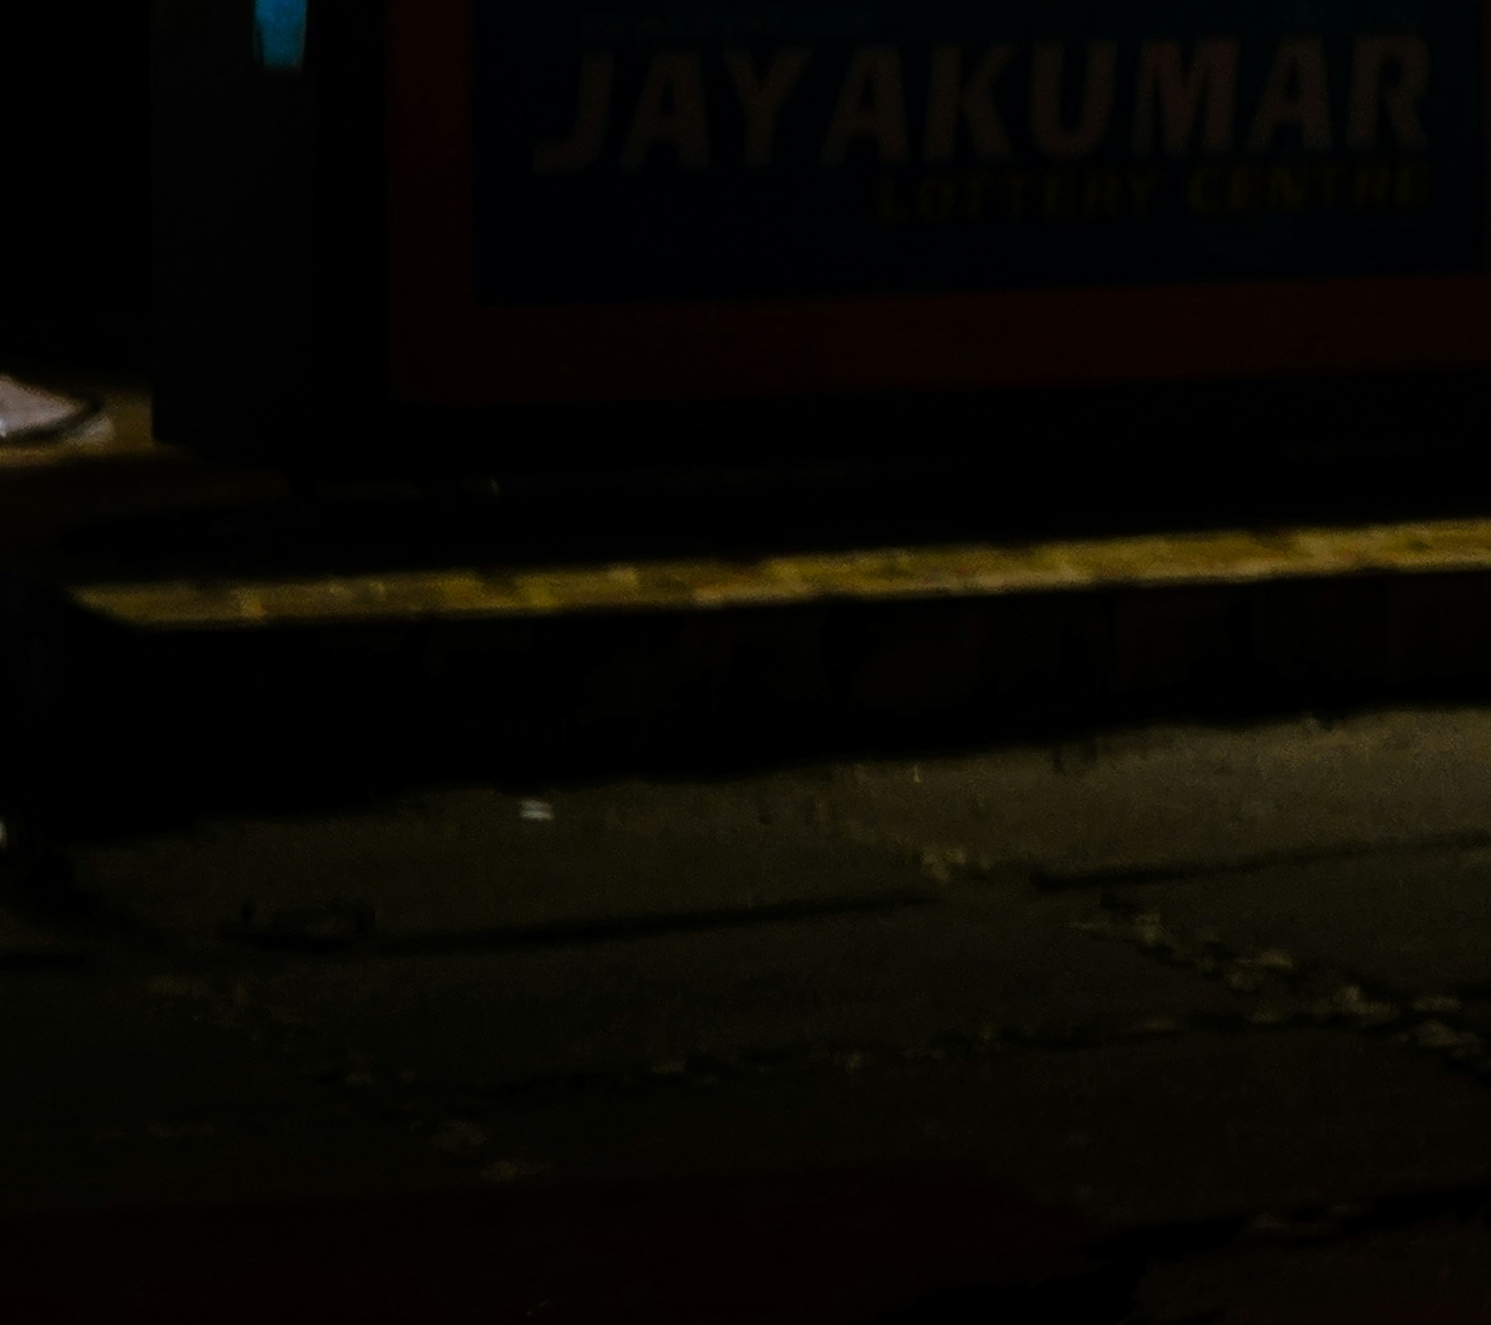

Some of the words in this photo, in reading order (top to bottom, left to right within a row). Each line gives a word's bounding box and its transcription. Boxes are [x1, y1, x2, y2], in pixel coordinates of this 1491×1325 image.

[530, 29, 1431, 176] JAYAKUMAR
[874, 163, 1164, 227] LOTTERY
[1182, 157, 1432, 216] CENTRE
